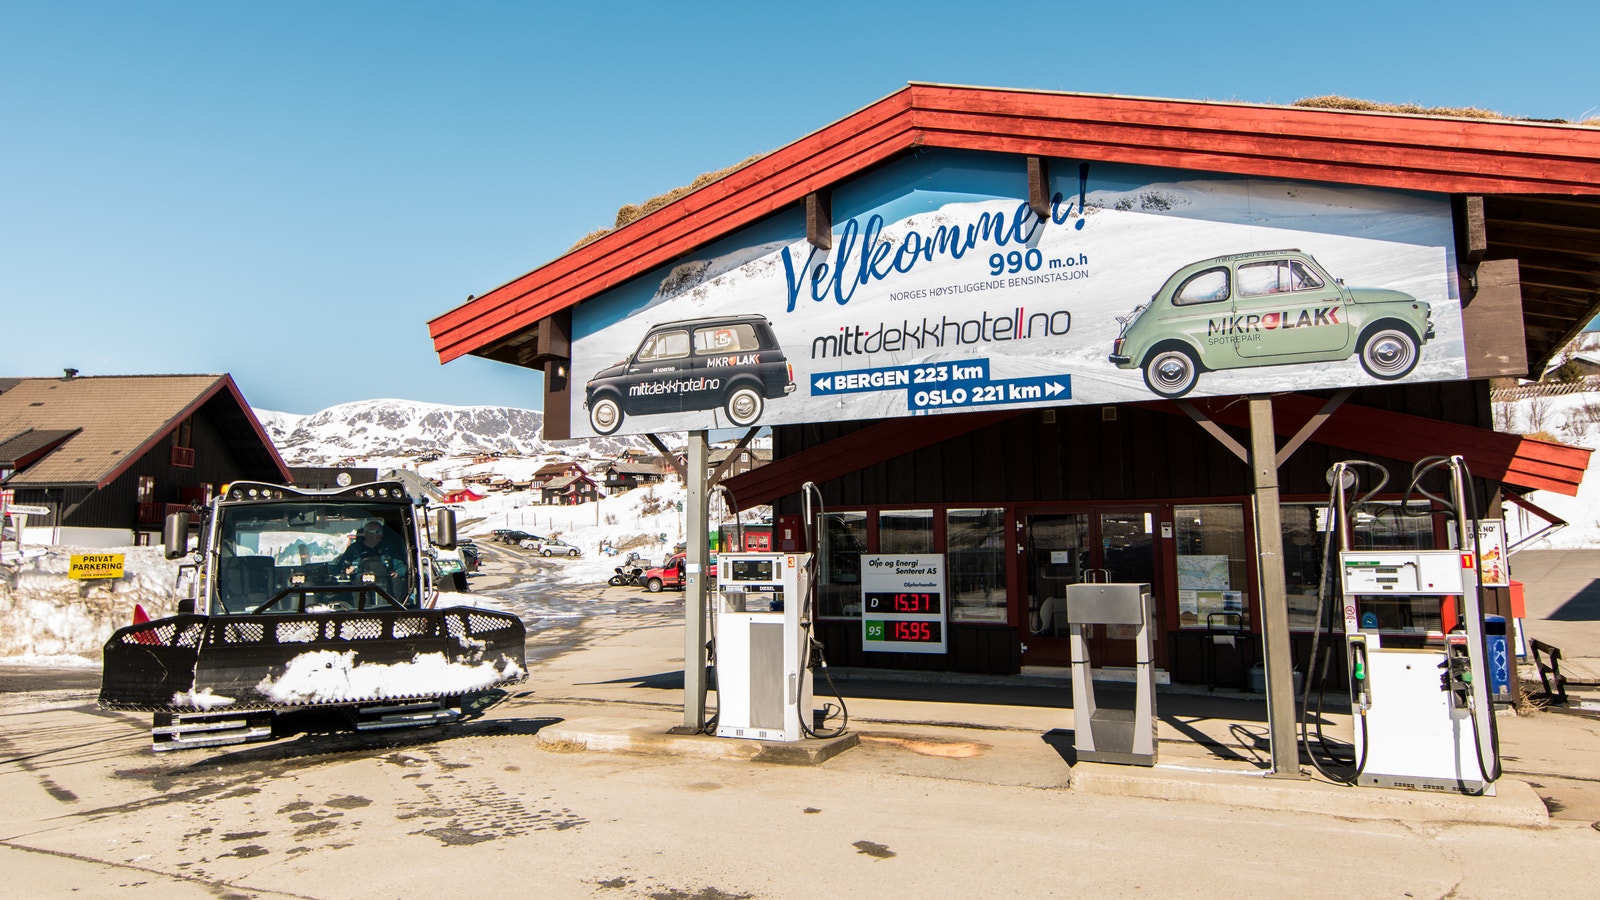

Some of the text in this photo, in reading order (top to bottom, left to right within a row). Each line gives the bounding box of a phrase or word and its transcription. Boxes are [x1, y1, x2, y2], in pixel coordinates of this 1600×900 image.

[781, 162, 1089, 312] Velkommen!
[988, 248, 1088, 276] 990 m.o.h
[890, 270, 1089, 302] NORGES HØYSTLIGGENDE BENSINSTASJON
[1208, 334, 1261, 346] SPOTREPAIR
[834, 364, 983, 391] BERGEN 223 km
[915, 383, 1041, 407] OSLO 221 km
[788, 557, 794, 567] 3
[869, 558, 883, 568] Olje
[896, 560, 918, 568] Energi
[1464, 556, 1470, 567] 1
[870, 597, 879, 607] D
[868, 626, 881, 636] 95
